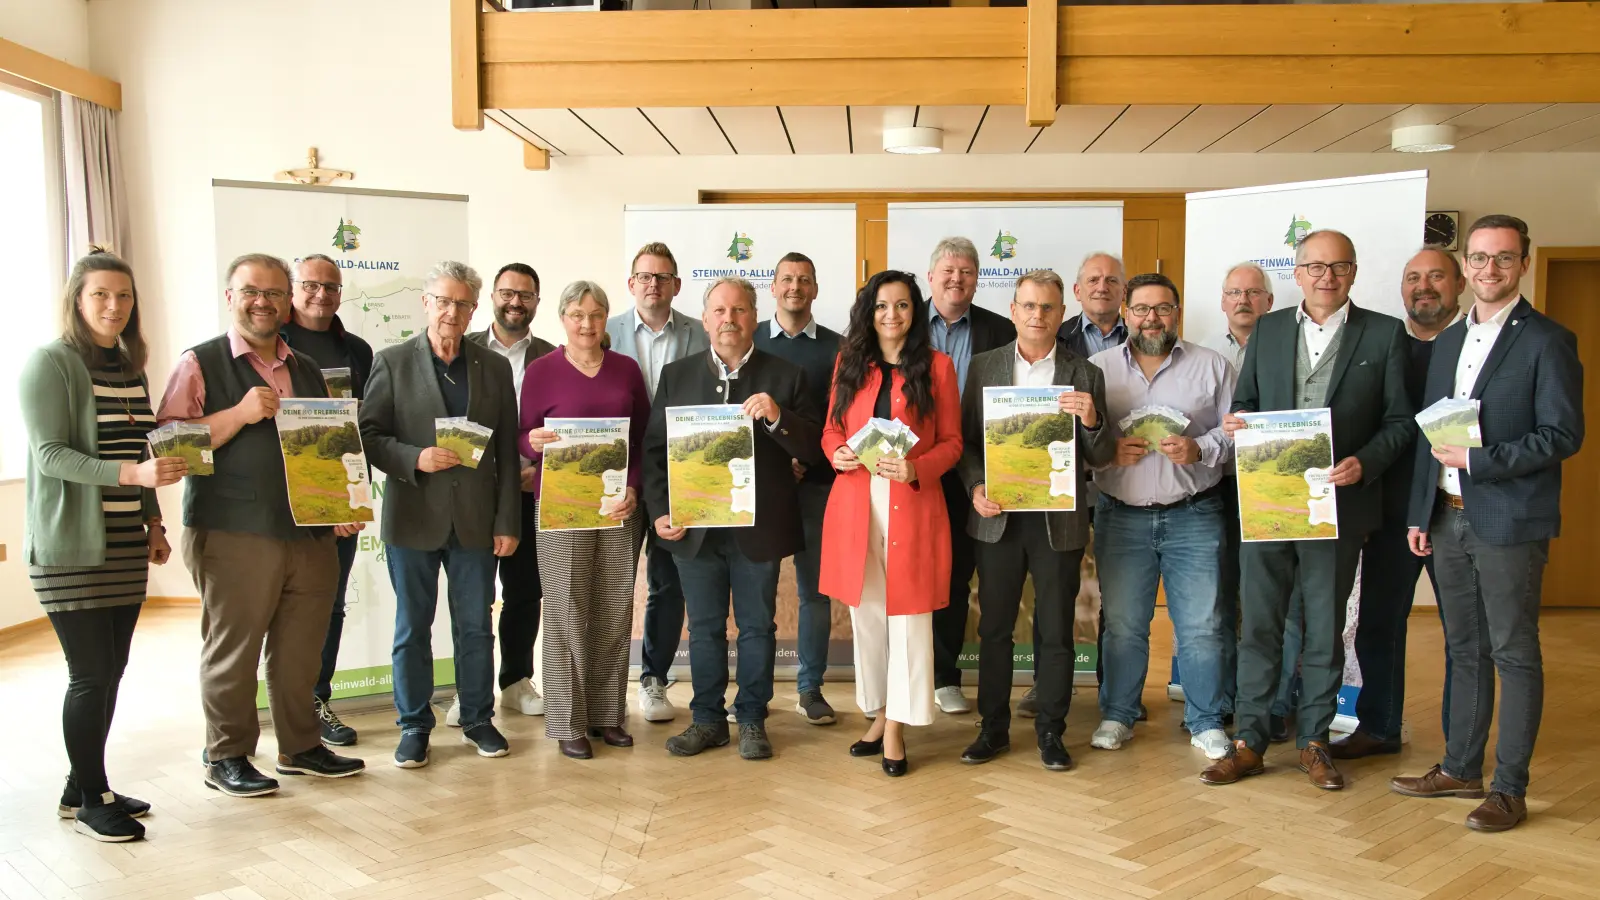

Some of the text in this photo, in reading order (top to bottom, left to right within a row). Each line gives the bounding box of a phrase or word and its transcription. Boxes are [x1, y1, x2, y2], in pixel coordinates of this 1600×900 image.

[692, 269, 776, 278] STEINWALD-ALLIA
[1026, 395, 1061, 403] ERLEBNIS
[1278, 420, 1322, 429] ERLEBNISSE
